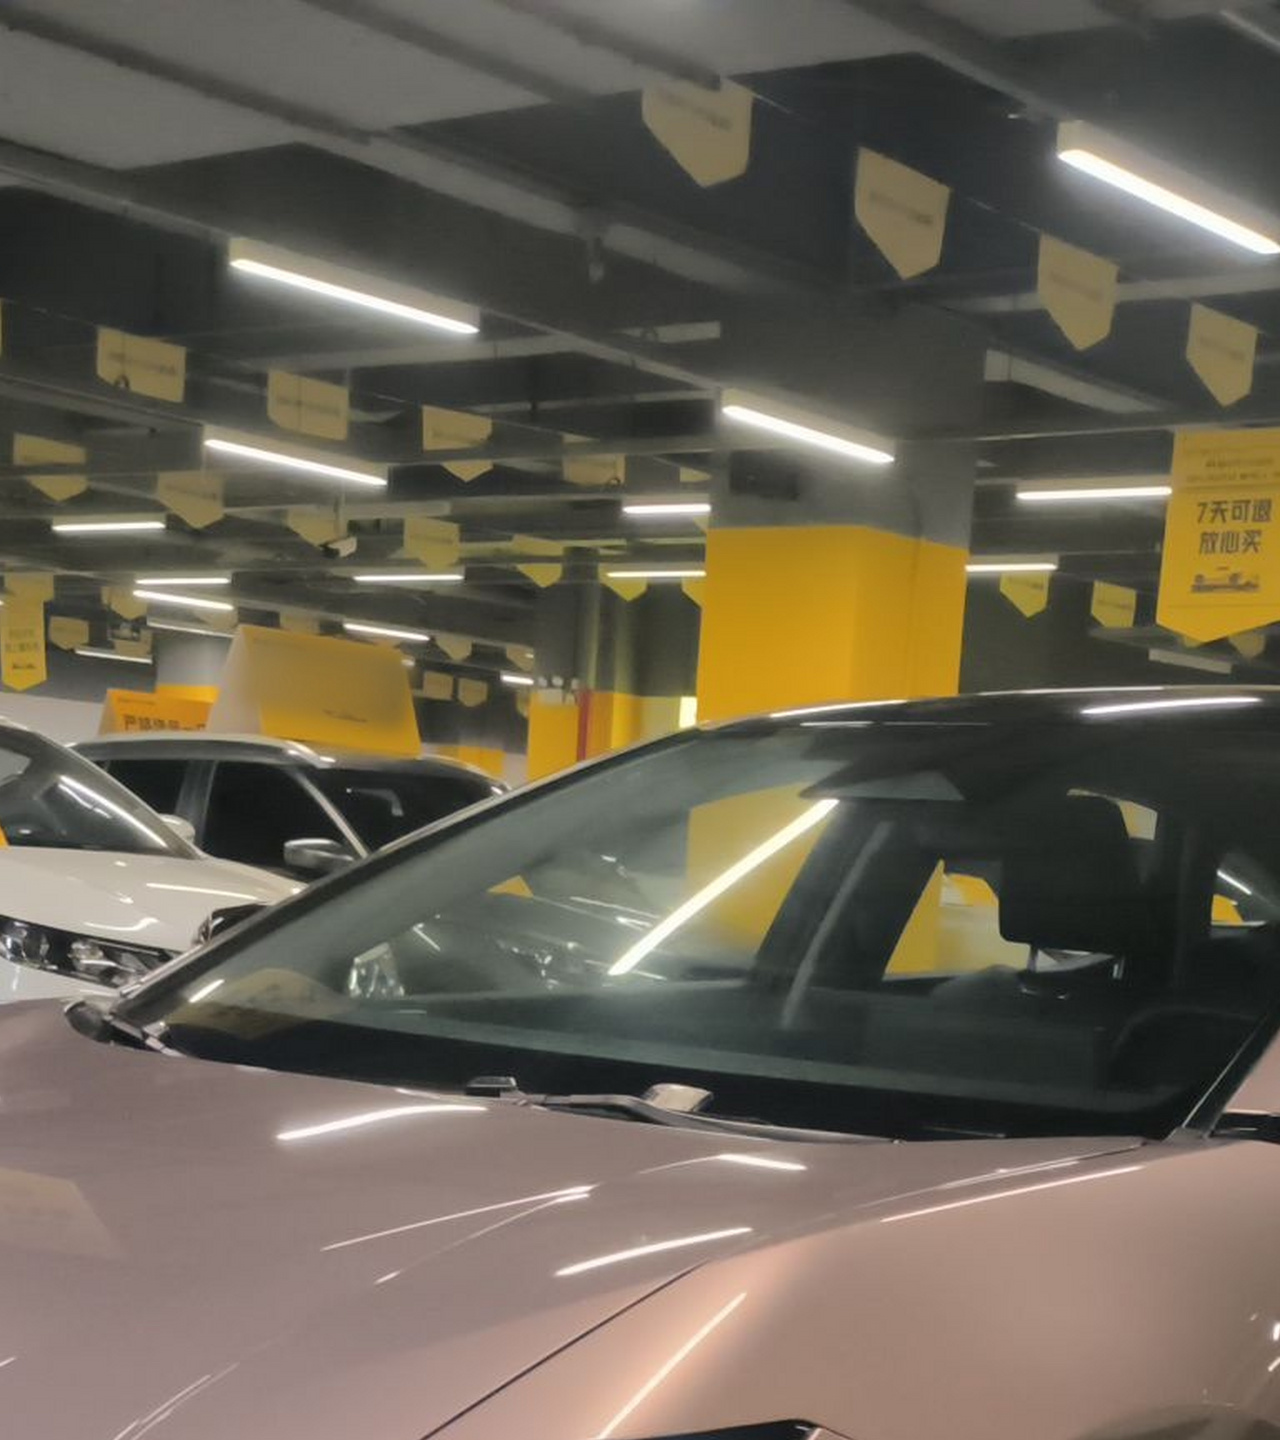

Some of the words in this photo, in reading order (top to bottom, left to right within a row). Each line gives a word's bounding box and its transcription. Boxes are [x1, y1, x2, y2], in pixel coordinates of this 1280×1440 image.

[1197, 499, 1273, 524] 7天可退
[1200, 530, 1262, 555] 放心买
